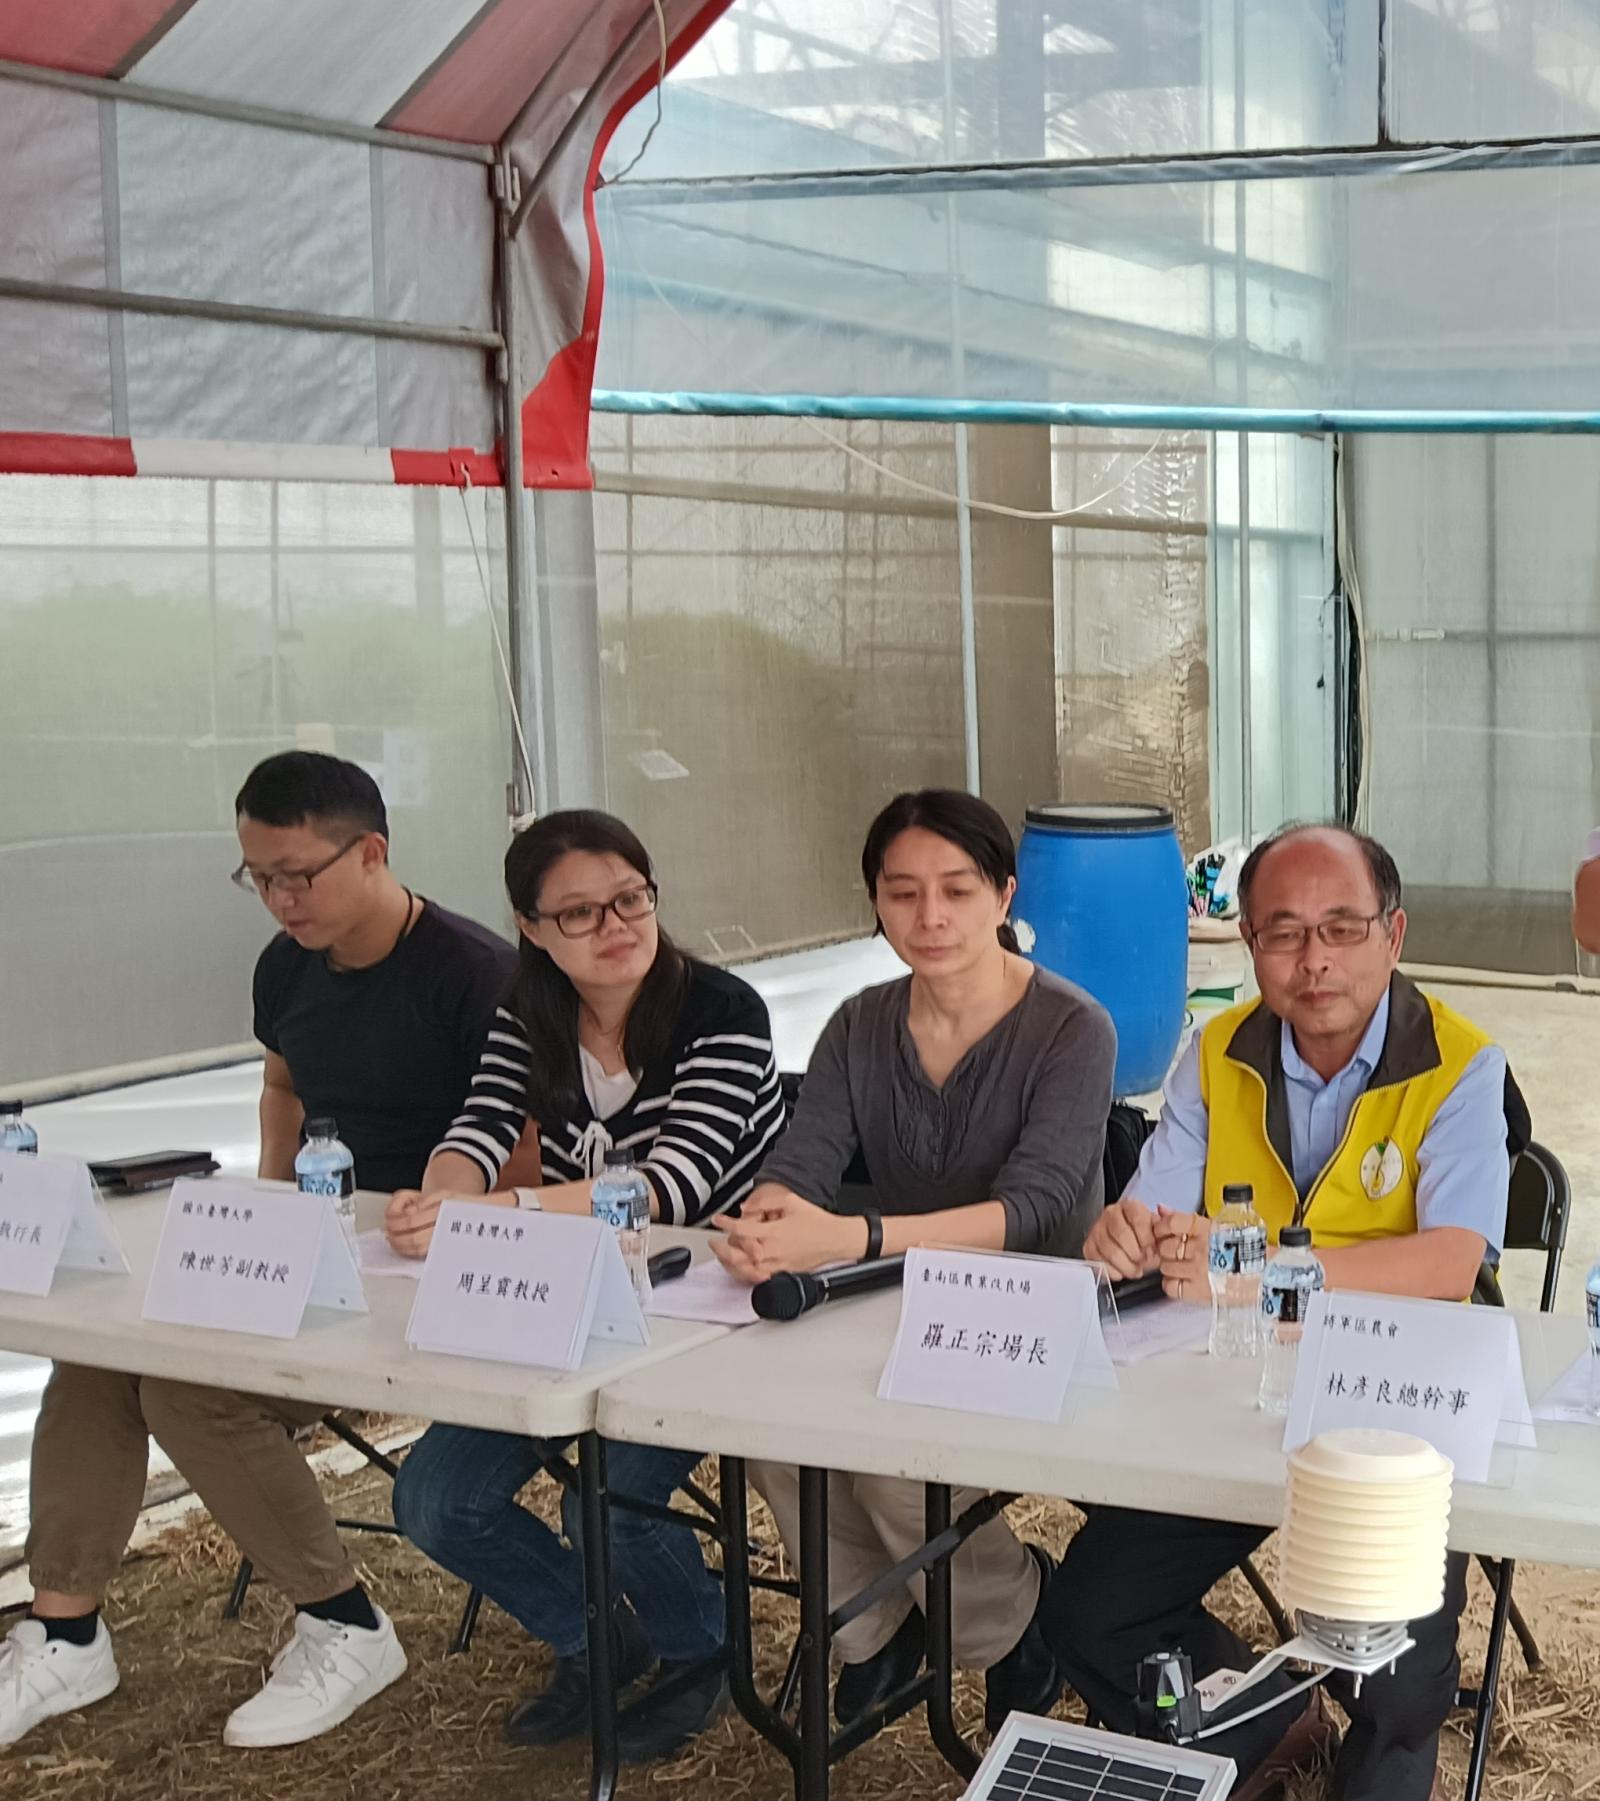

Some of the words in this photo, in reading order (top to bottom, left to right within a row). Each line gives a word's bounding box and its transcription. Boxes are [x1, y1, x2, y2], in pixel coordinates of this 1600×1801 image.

[920, 1322, 1048, 1366] 羅正宗場長
